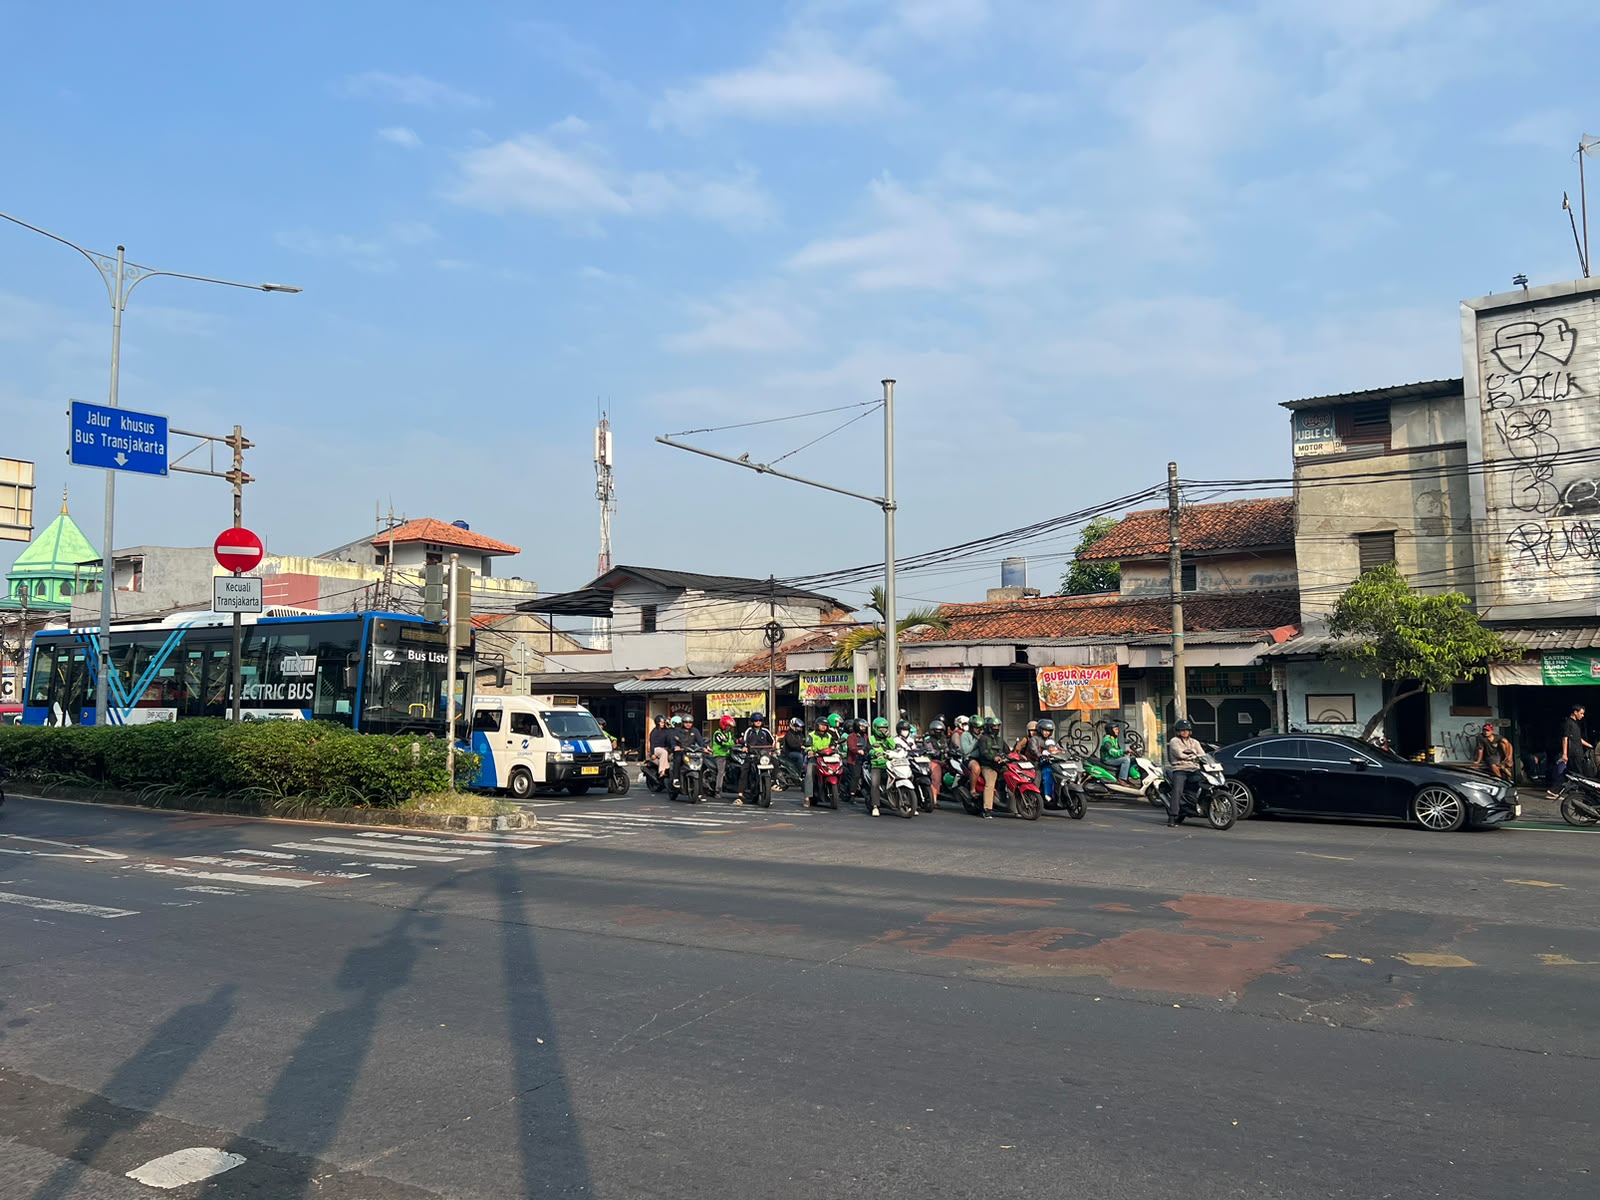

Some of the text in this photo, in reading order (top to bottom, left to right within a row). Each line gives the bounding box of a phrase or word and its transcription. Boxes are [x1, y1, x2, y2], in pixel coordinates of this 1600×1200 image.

[86, 410, 155, 435] Jalur khusus
[75, 429, 165, 455] Bus Transjakarta
[1298, 443, 1324, 452] MOTOR
[225, 582, 251, 592] Kecuali
[217, 595, 260, 609] Transjakarta
[408, 649, 449, 664] Bus Listr
[820, 675, 849, 683] SEMBAKO
[1043, 669, 1111, 683] BUBUR AYAM
[228, 682, 314, 701] EECTRIC BUS
[806, 684, 849, 695] ANUGERAH
